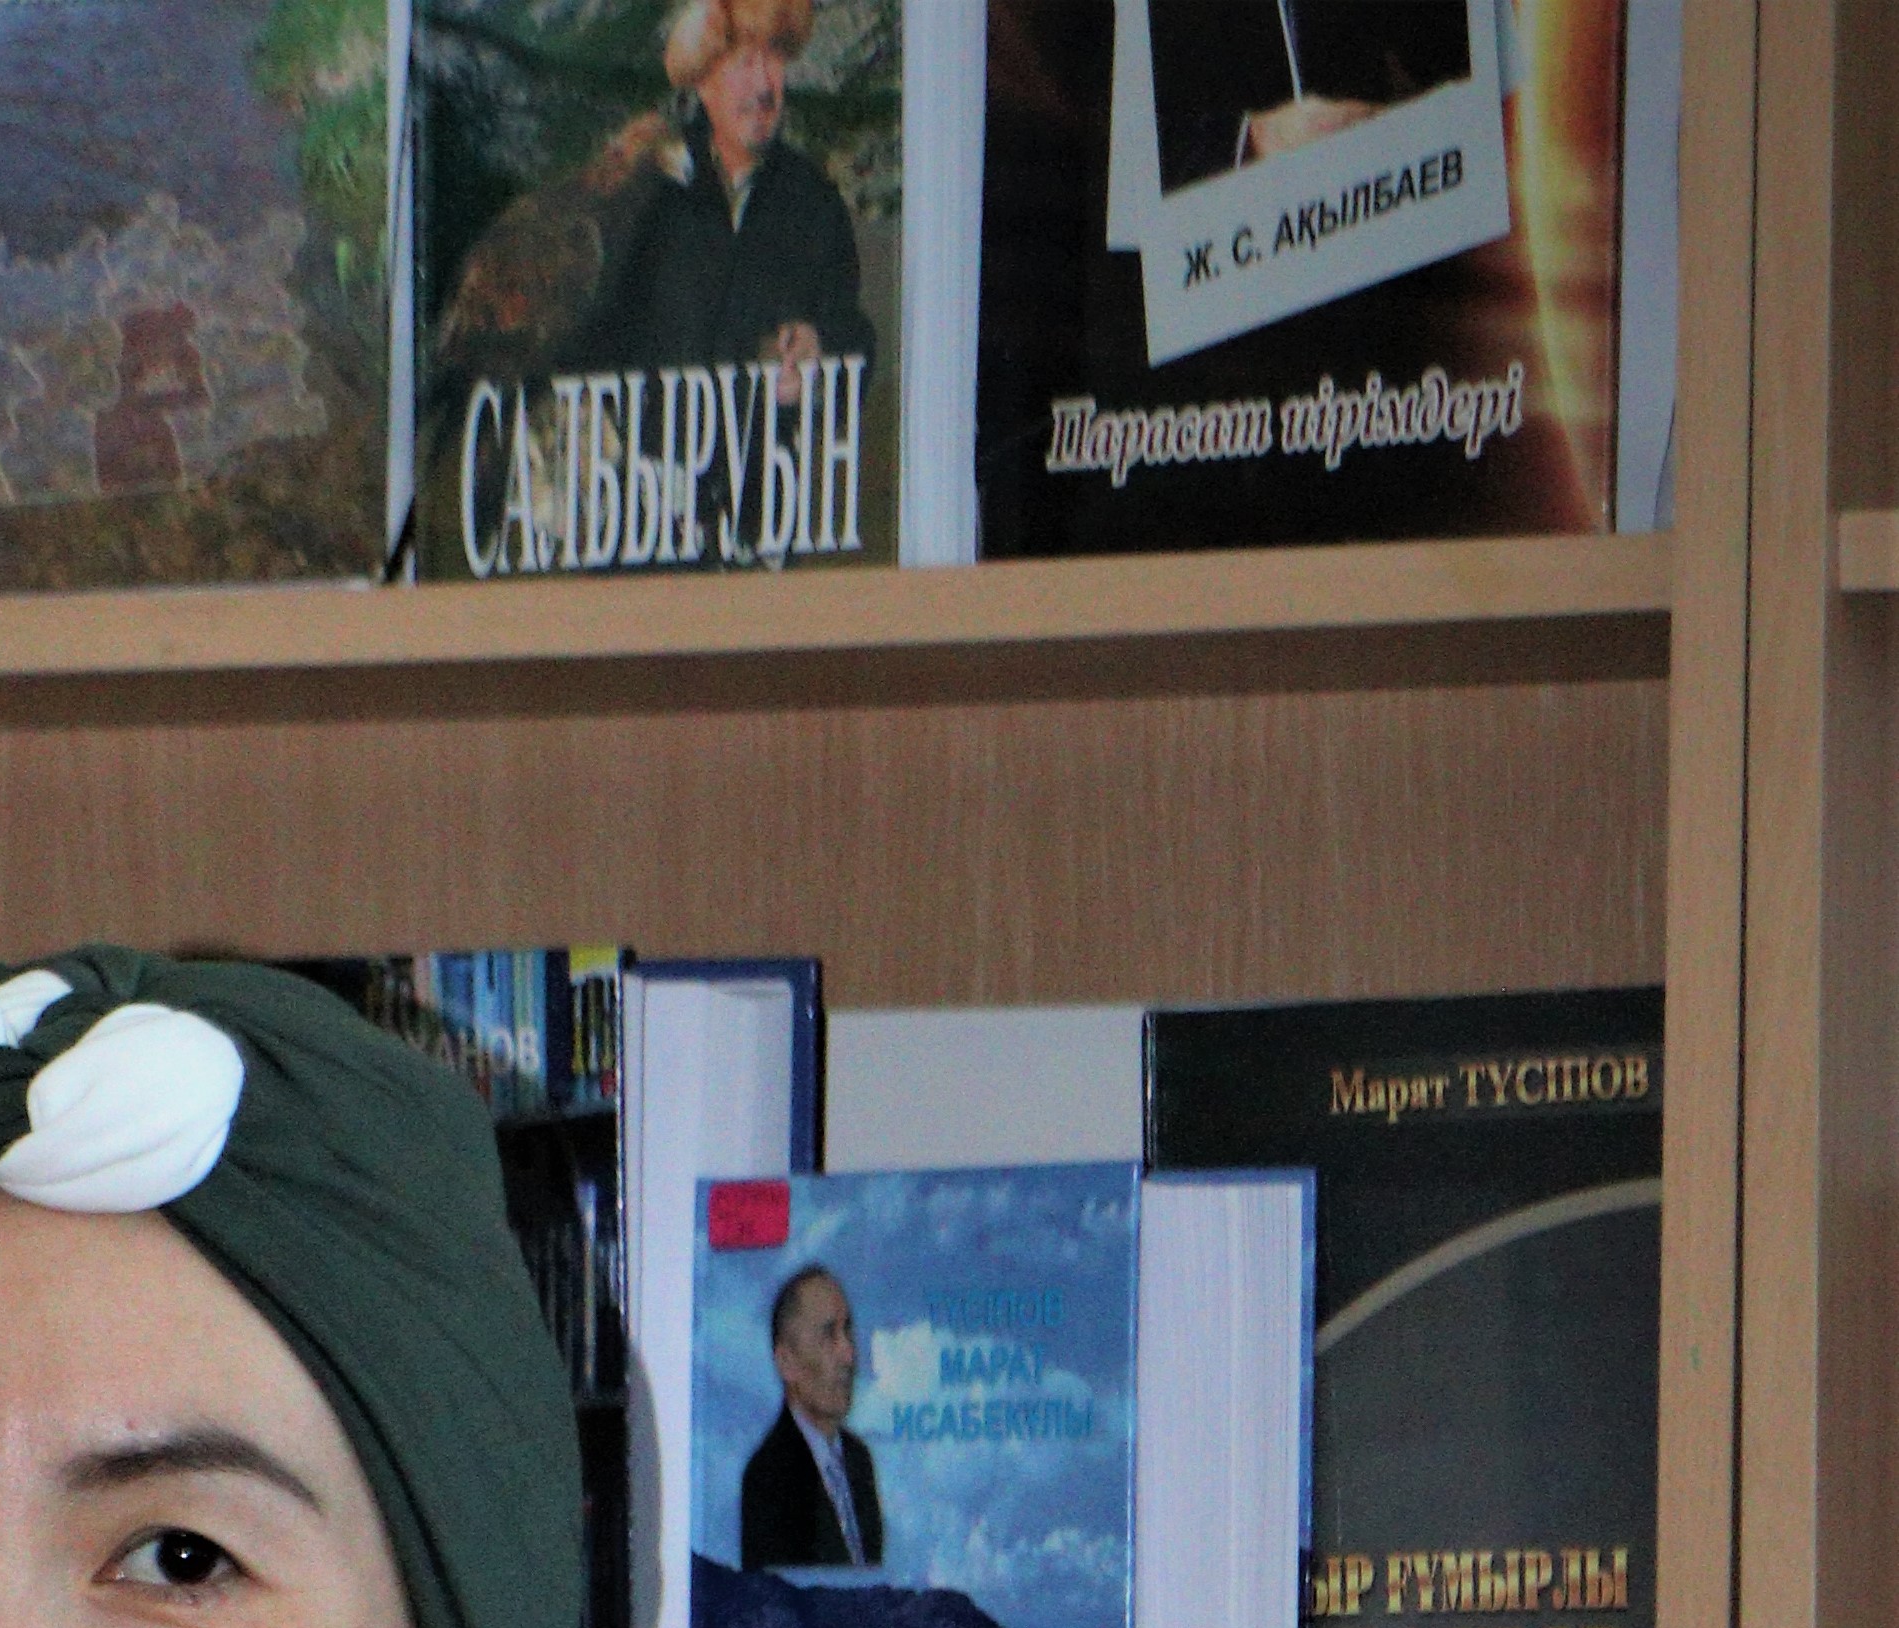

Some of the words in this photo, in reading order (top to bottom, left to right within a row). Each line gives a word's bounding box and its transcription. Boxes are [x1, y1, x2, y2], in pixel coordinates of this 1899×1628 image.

[1183, 243, 1220, 290] Ж.
[1232, 225, 1262, 267] С.
[1273, 148, 1465, 253] АҚЫЛБАЕВ
[460, 353, 868, 580] САЛБЫРУЫН
[1045, 394, 1275, 489] Парасат
[1328, 1065, 1450, 1124] Марат
[939, 1342, 1047, 1387] МАРАТ
